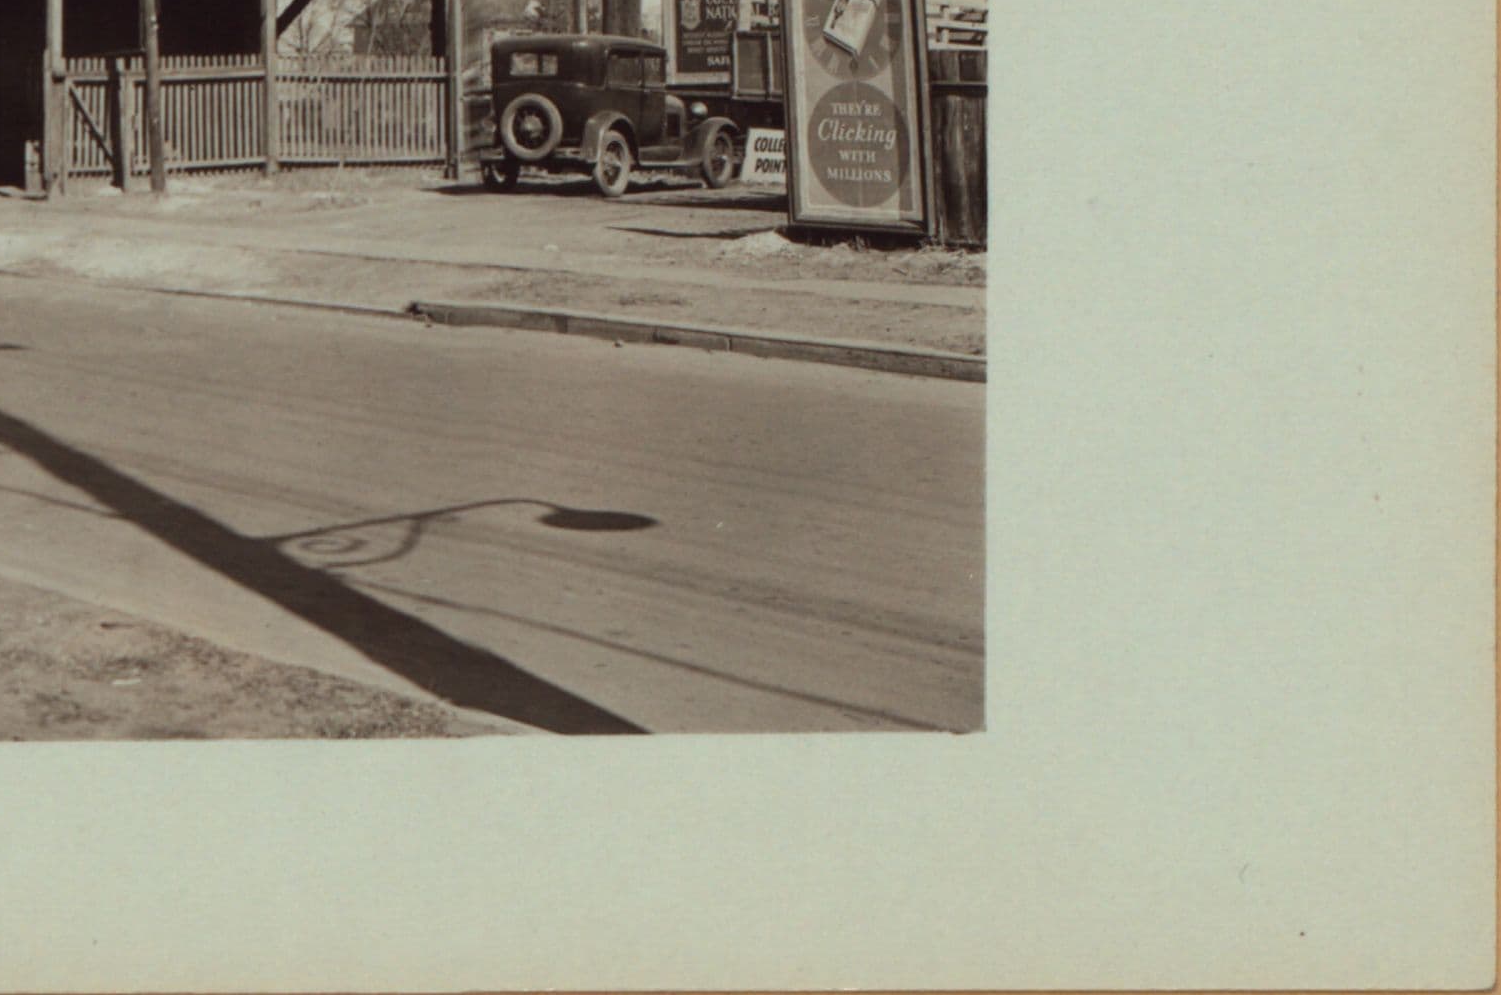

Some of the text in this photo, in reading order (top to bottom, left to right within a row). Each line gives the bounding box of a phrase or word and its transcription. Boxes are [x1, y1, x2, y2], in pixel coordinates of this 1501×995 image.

[830, 99, 882, 116] THEY'RE
[817, 117, 898, 151] Clicking
[754, 136, 786, 153] COLLE
[838, 149, 876, 163] WITH
[826, 166, 892, 183] MILLIONS
